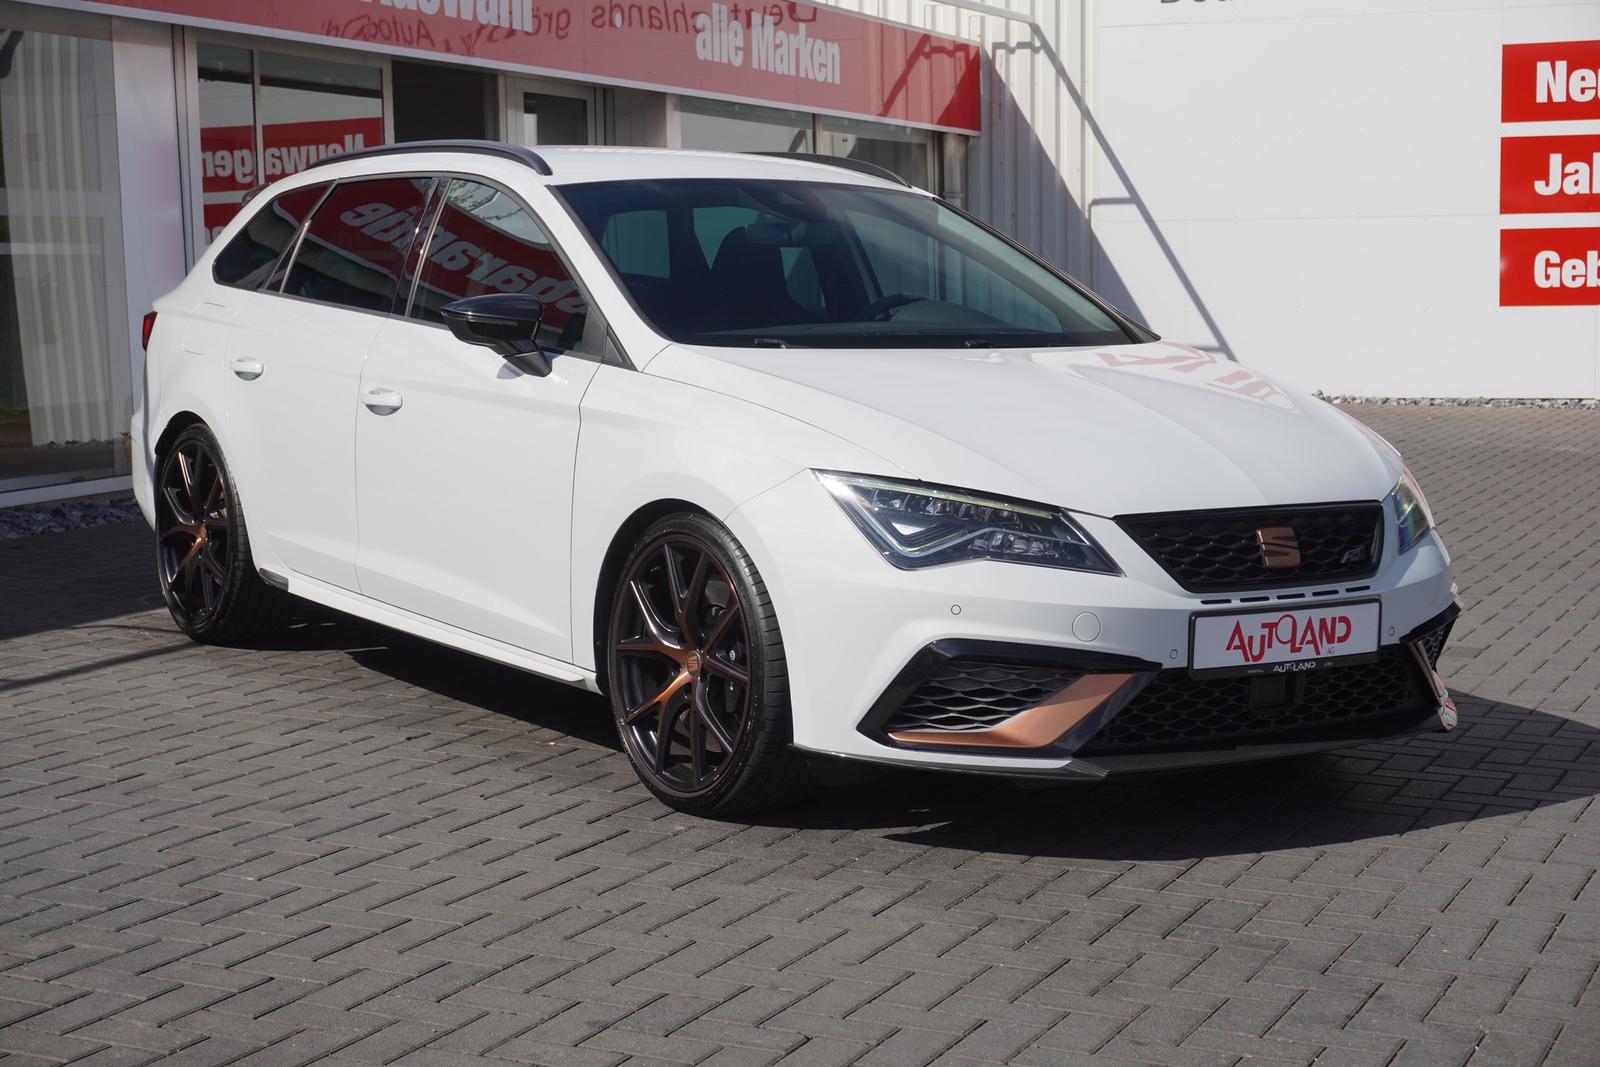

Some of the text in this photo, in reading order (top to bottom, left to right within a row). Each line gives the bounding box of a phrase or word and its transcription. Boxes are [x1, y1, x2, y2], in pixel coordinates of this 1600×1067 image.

[696, 3, 841, 84] alle Marken
[1536, 60, 1600, 103] Ne
[1226, 614, 1352, 662] AUTOLAND
